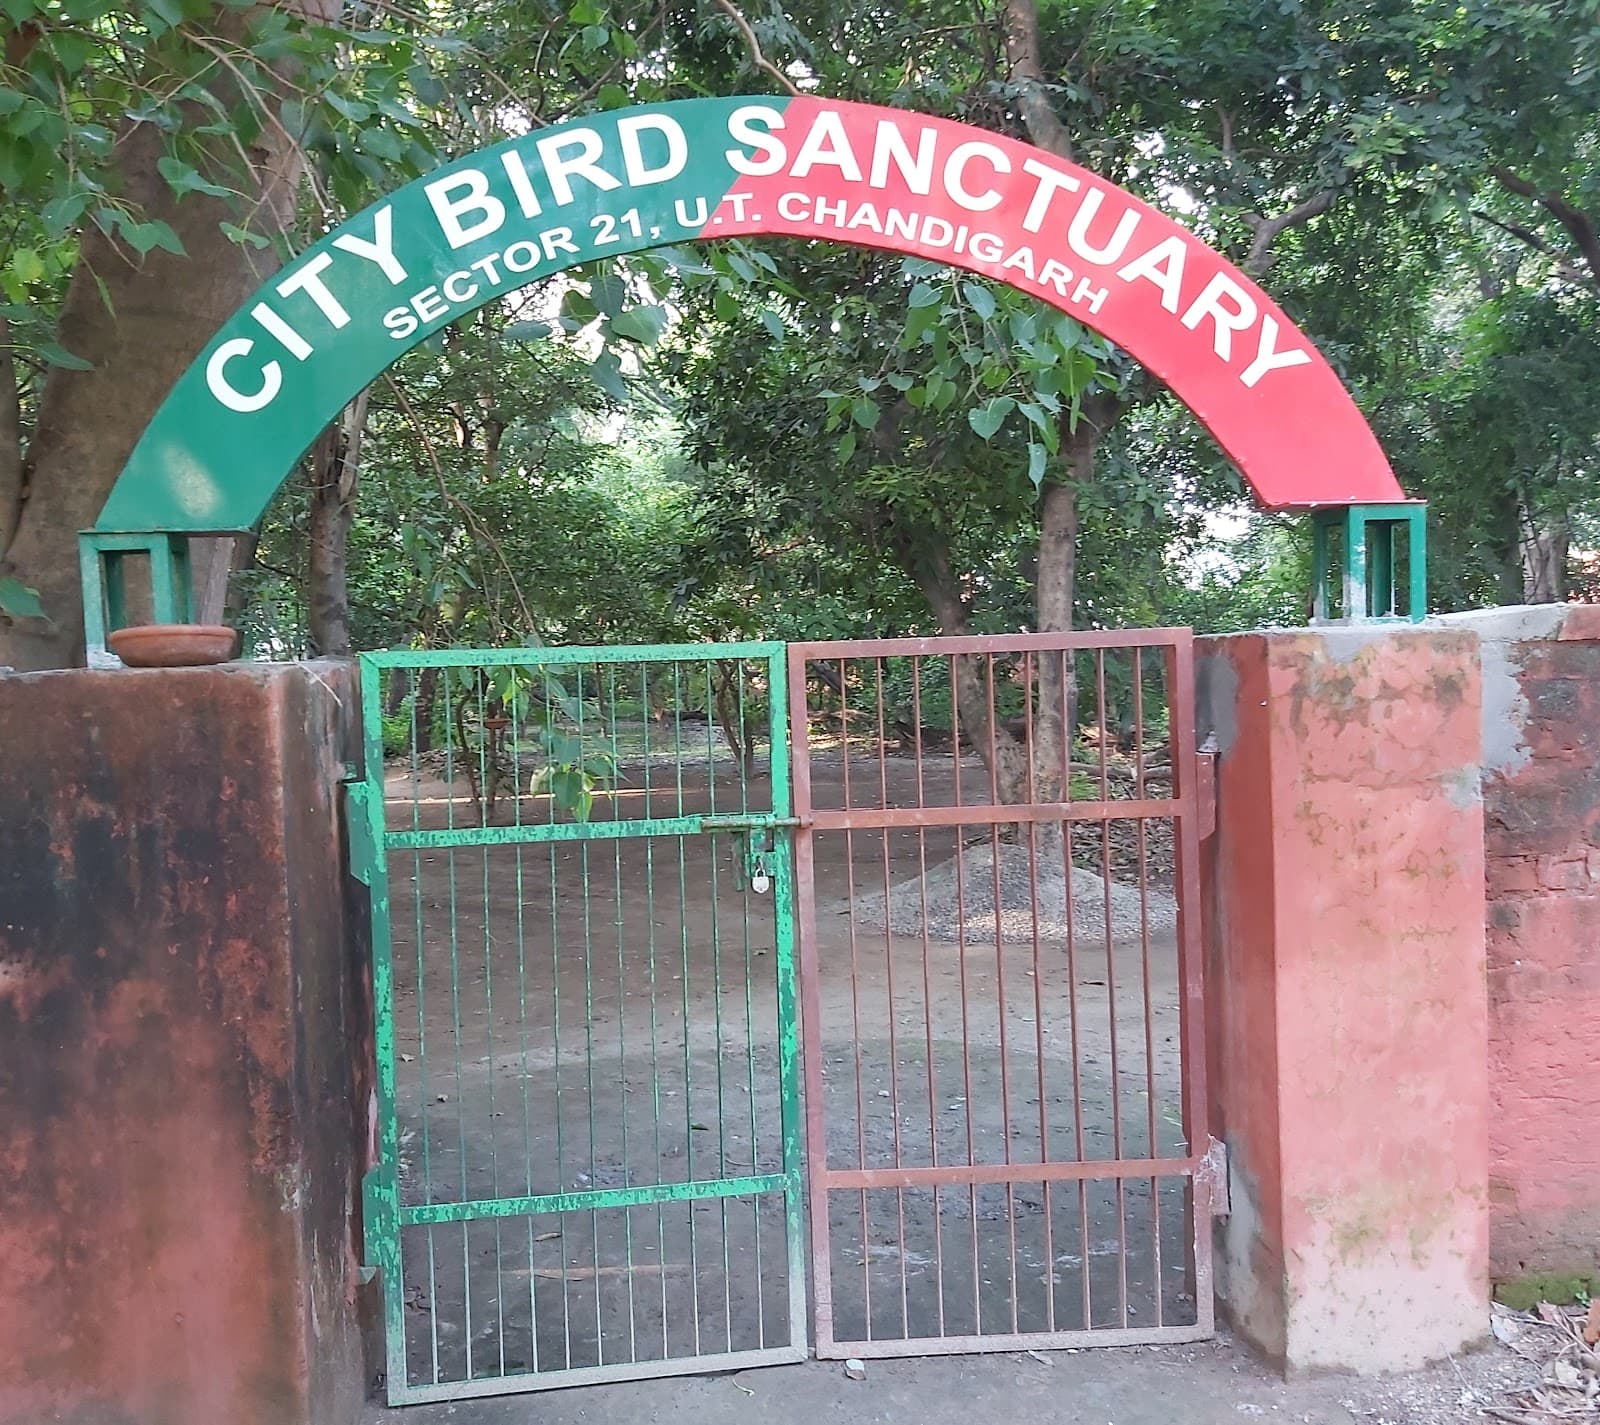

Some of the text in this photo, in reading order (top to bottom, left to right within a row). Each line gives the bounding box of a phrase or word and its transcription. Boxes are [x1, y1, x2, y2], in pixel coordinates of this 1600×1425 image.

[206, 104, 1313, 413] CITY BIRD SANCTUARY
[382, 191, 1110, 339] SECTOR 21, U.T. CHANDIGARH
